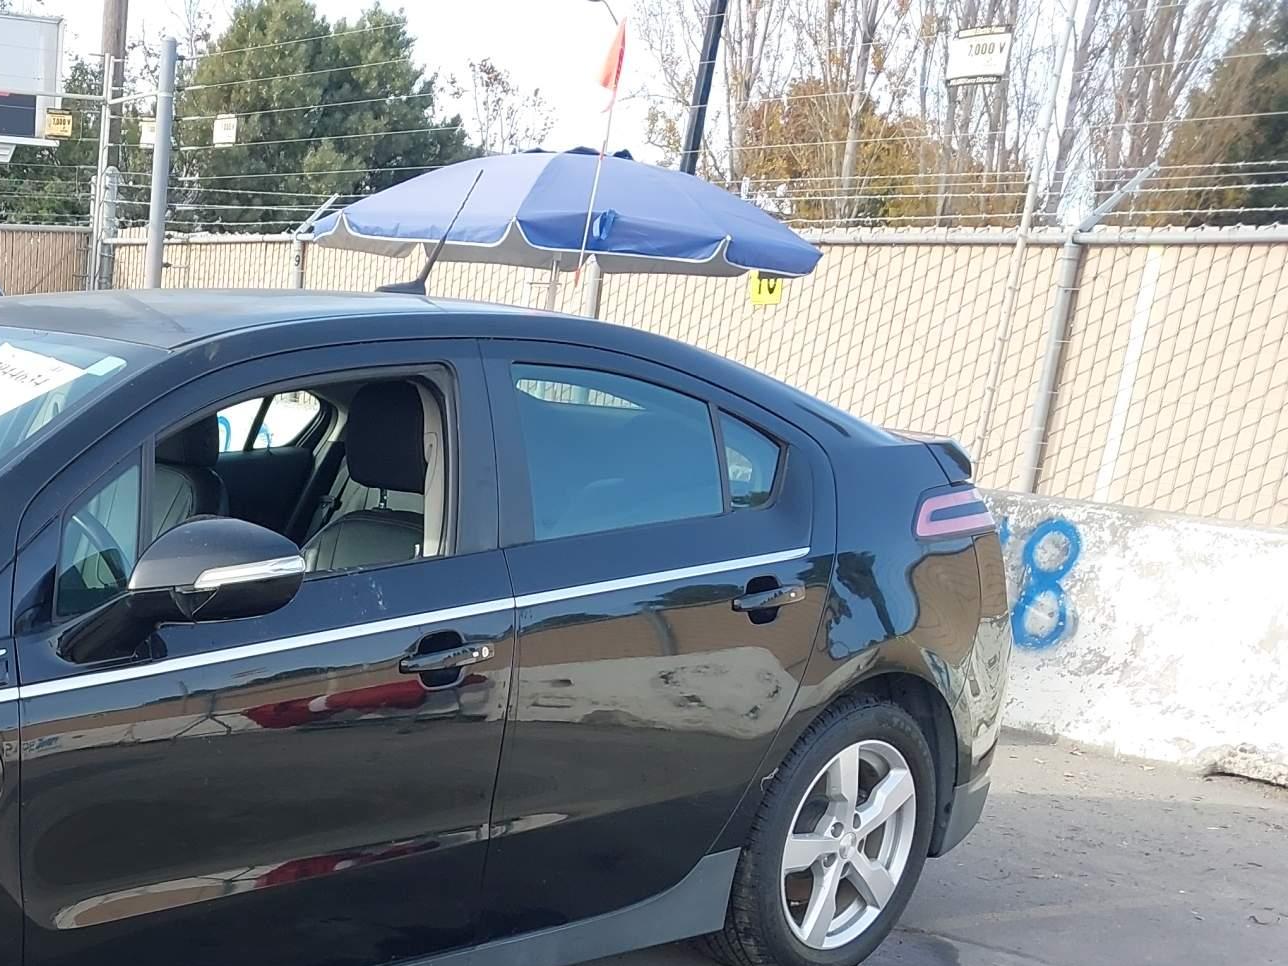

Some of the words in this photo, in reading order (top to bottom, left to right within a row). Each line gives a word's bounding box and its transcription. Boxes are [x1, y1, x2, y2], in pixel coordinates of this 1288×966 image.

[999, 41, 1007, 54] V
[294, 254, 301, 267] 9
[999, 515, 1081, 651] 8
